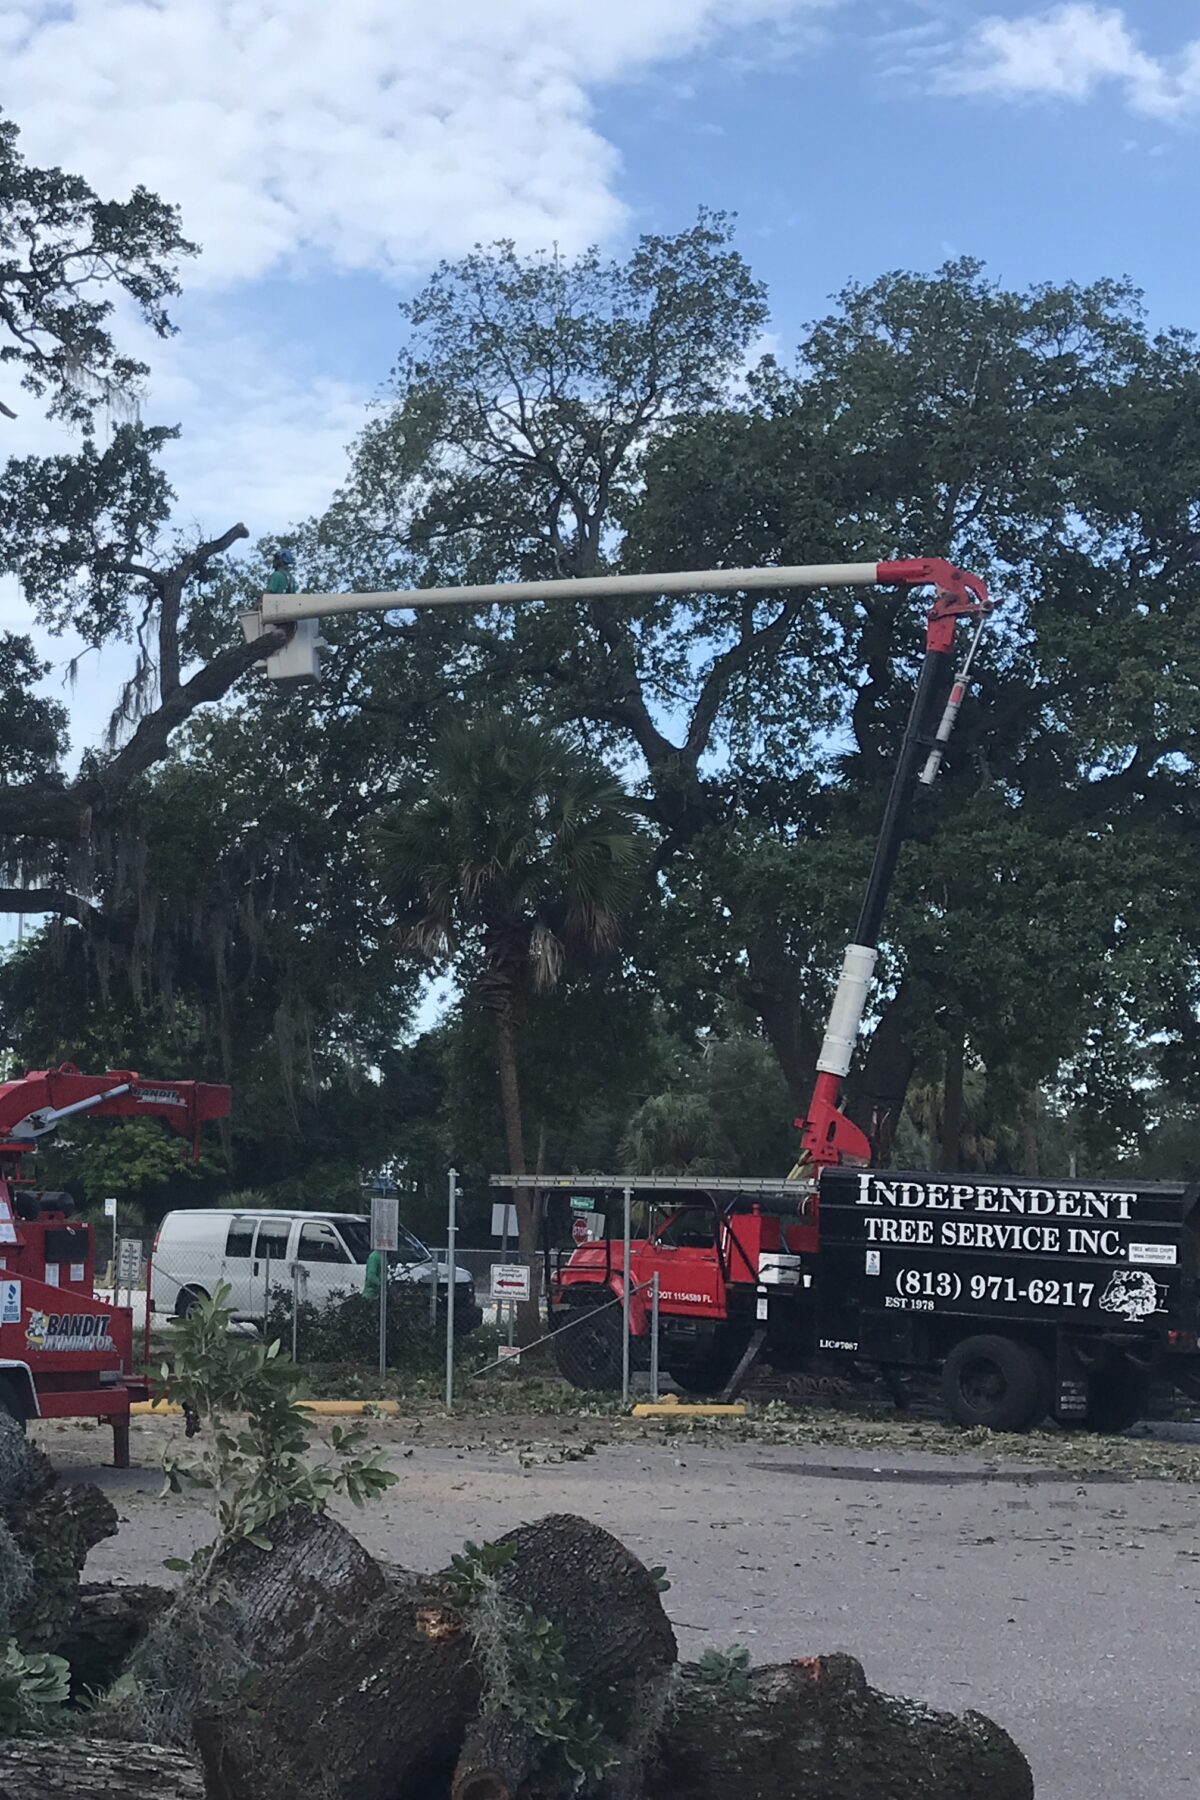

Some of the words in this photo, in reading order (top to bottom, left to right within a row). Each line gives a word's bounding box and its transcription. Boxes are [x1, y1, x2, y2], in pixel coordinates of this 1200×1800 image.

[855, 1173, 1138, 1219] INDEPENDENT
[864, 1218, 934, 1243] TREE
[941, 1221, 1060, 1251] SERVICE
[1067, 1228, 1126, 1256] INC.
[647, 1289, 673, 1300] UDOT
[702, 1295, 713, 1303] FL
[896, 1269, 961, 1300] (813)
[970, 1275, 1095, 1307] 971-6217
[4, 1305, 19, 1314] BBB
[885, 1297, 908, 1308] EST
[911, 1299, 935, 1310] 1978
[46, 1314, 111, 1337] BANDIT
